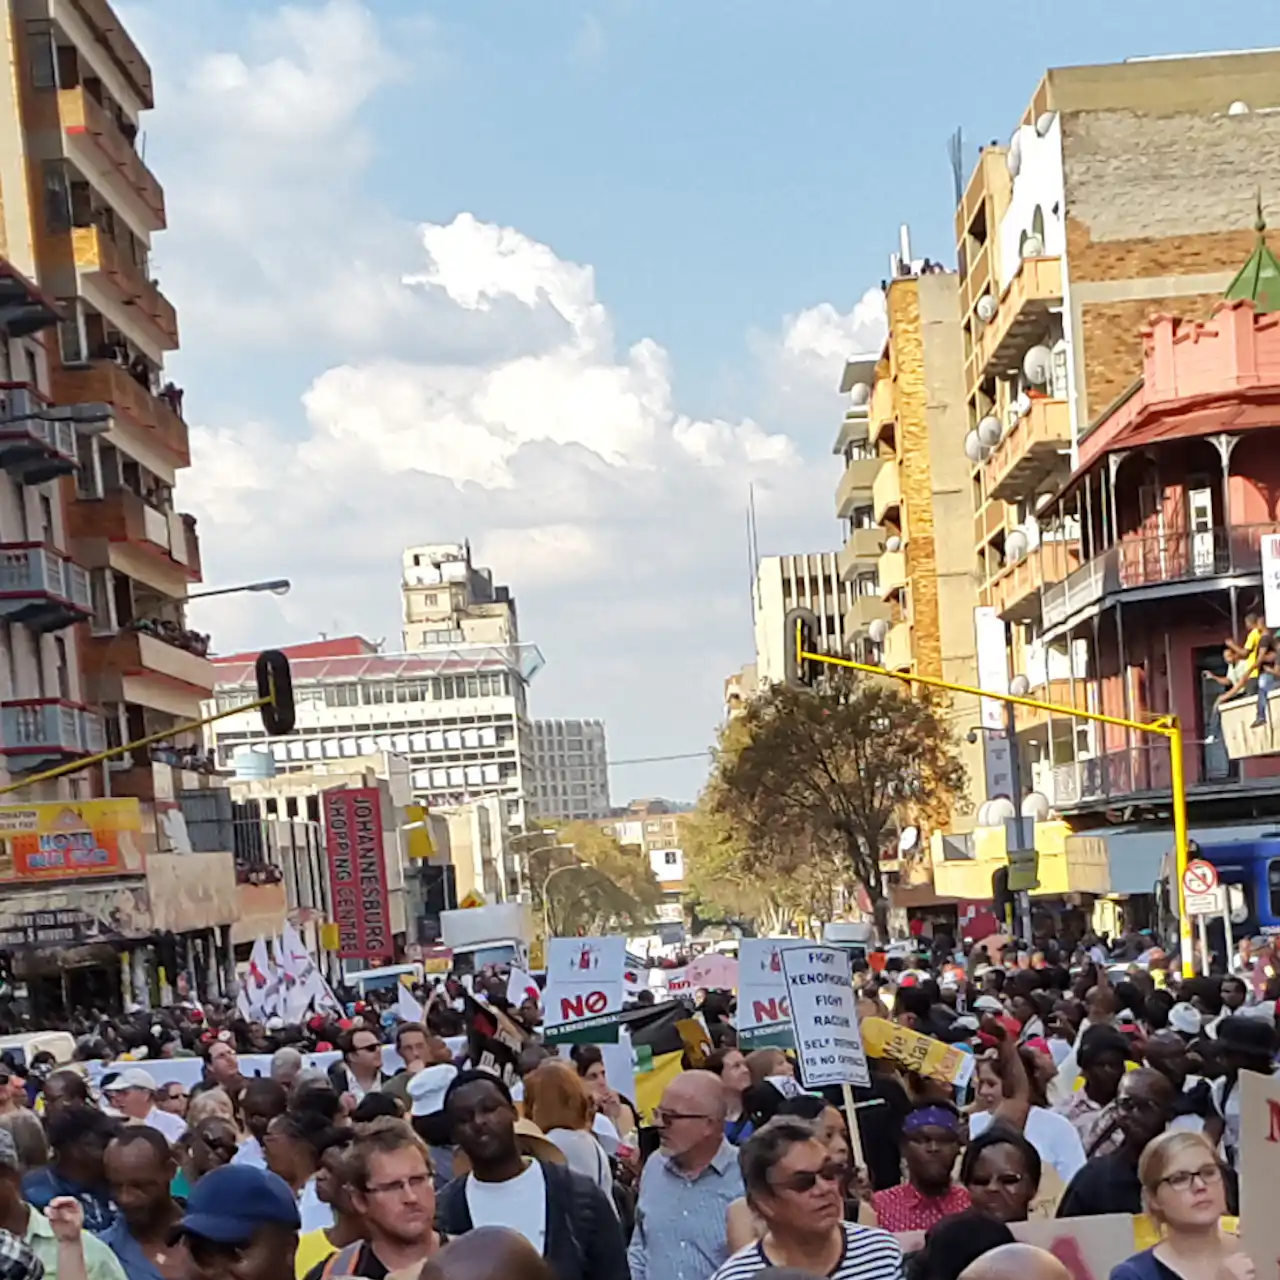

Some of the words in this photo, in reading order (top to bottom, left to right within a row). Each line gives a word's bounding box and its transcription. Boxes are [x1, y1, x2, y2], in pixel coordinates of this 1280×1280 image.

[330, 796, 352, 882] SHOPPING
[354, 794, 384, 951] JOHANNESBURG
[338, 886, 358, 953] CENTRE
[560, 991, 608, 1020] NO
